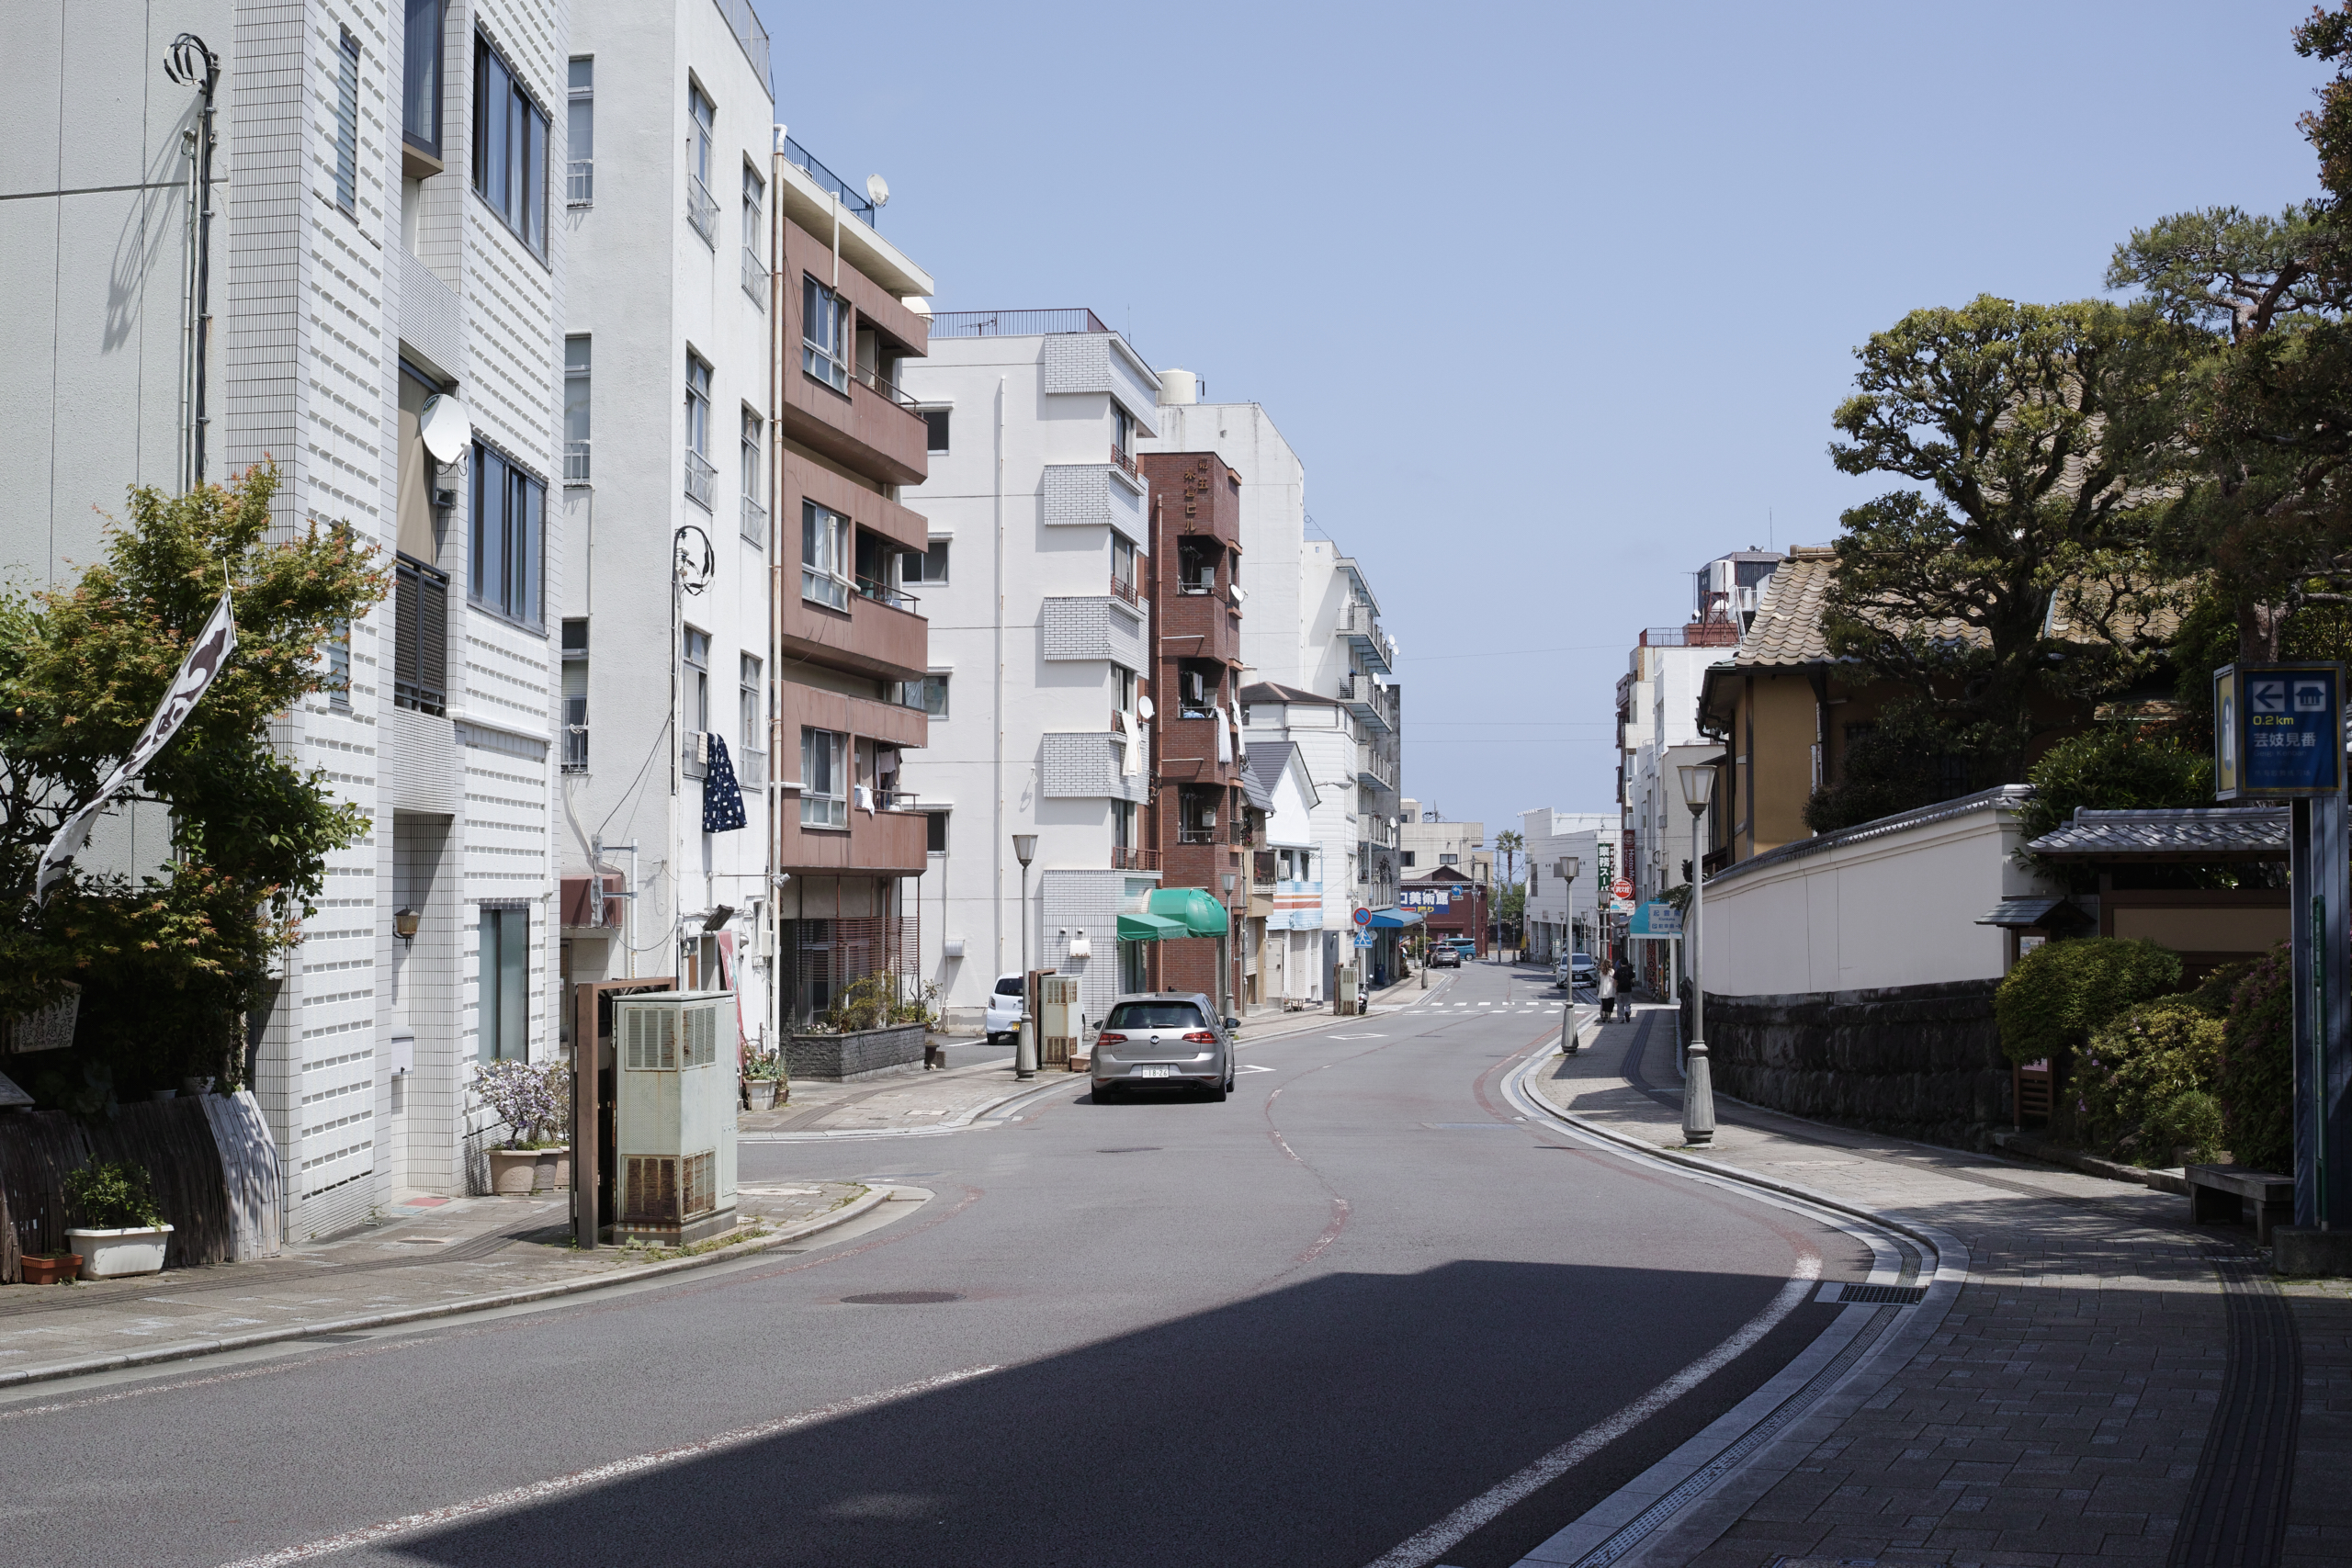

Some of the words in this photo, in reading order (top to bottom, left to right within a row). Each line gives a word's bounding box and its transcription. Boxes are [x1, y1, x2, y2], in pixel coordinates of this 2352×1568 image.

[2253, 716, 2274, 726] 0.2
[2276, 716, 2294, 726] km
[2254, 732, 2316, 747] 芸妓見番
[1599, 846, 1610, 891] 業務スーパ
